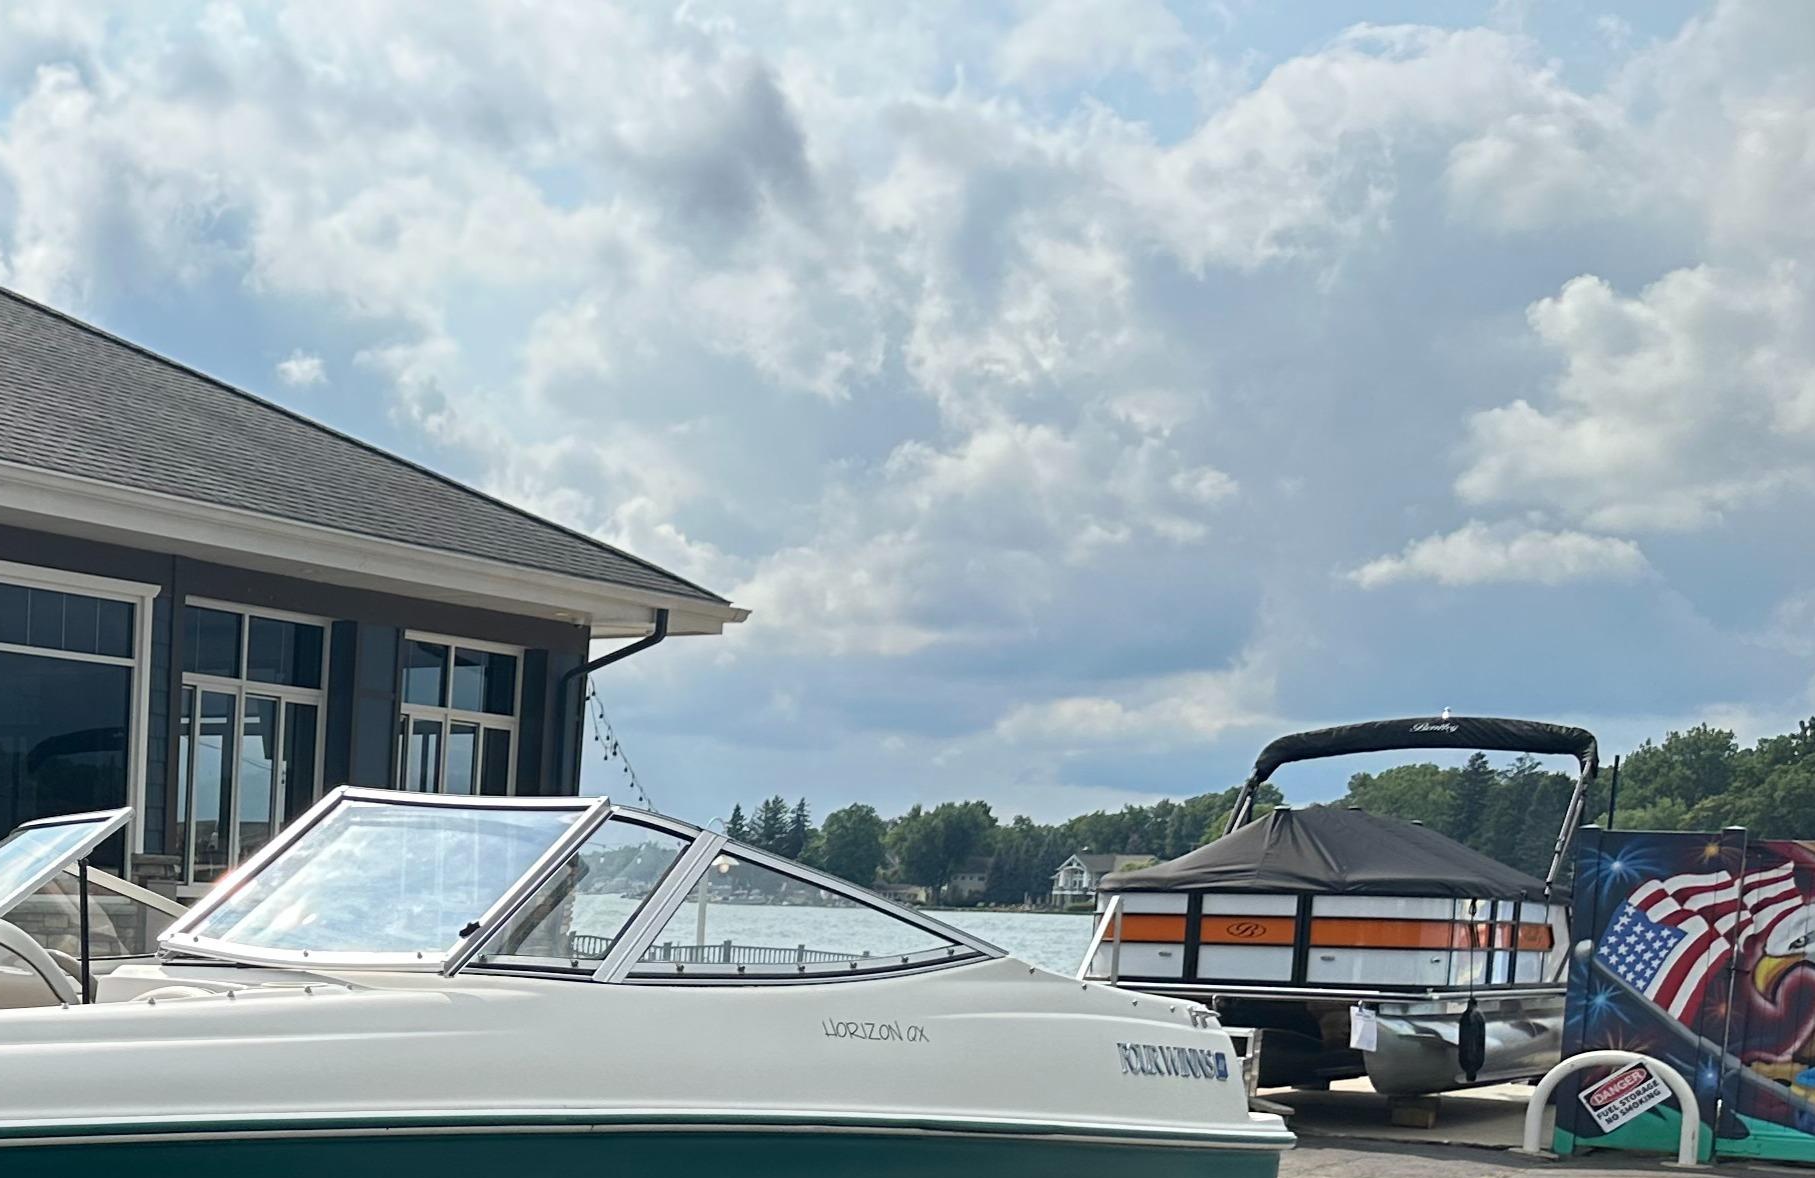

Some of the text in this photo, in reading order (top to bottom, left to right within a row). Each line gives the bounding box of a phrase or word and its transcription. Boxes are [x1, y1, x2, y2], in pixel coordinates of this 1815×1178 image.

[822, 1018, 904, 1041] HORIZON
[1594, 1071, 1642, 1104] DANGER
[1596, 1079, 1659, 1120] FUEL STORAGE
[1605, 1089, 1661, 1124] NO SMOKING
